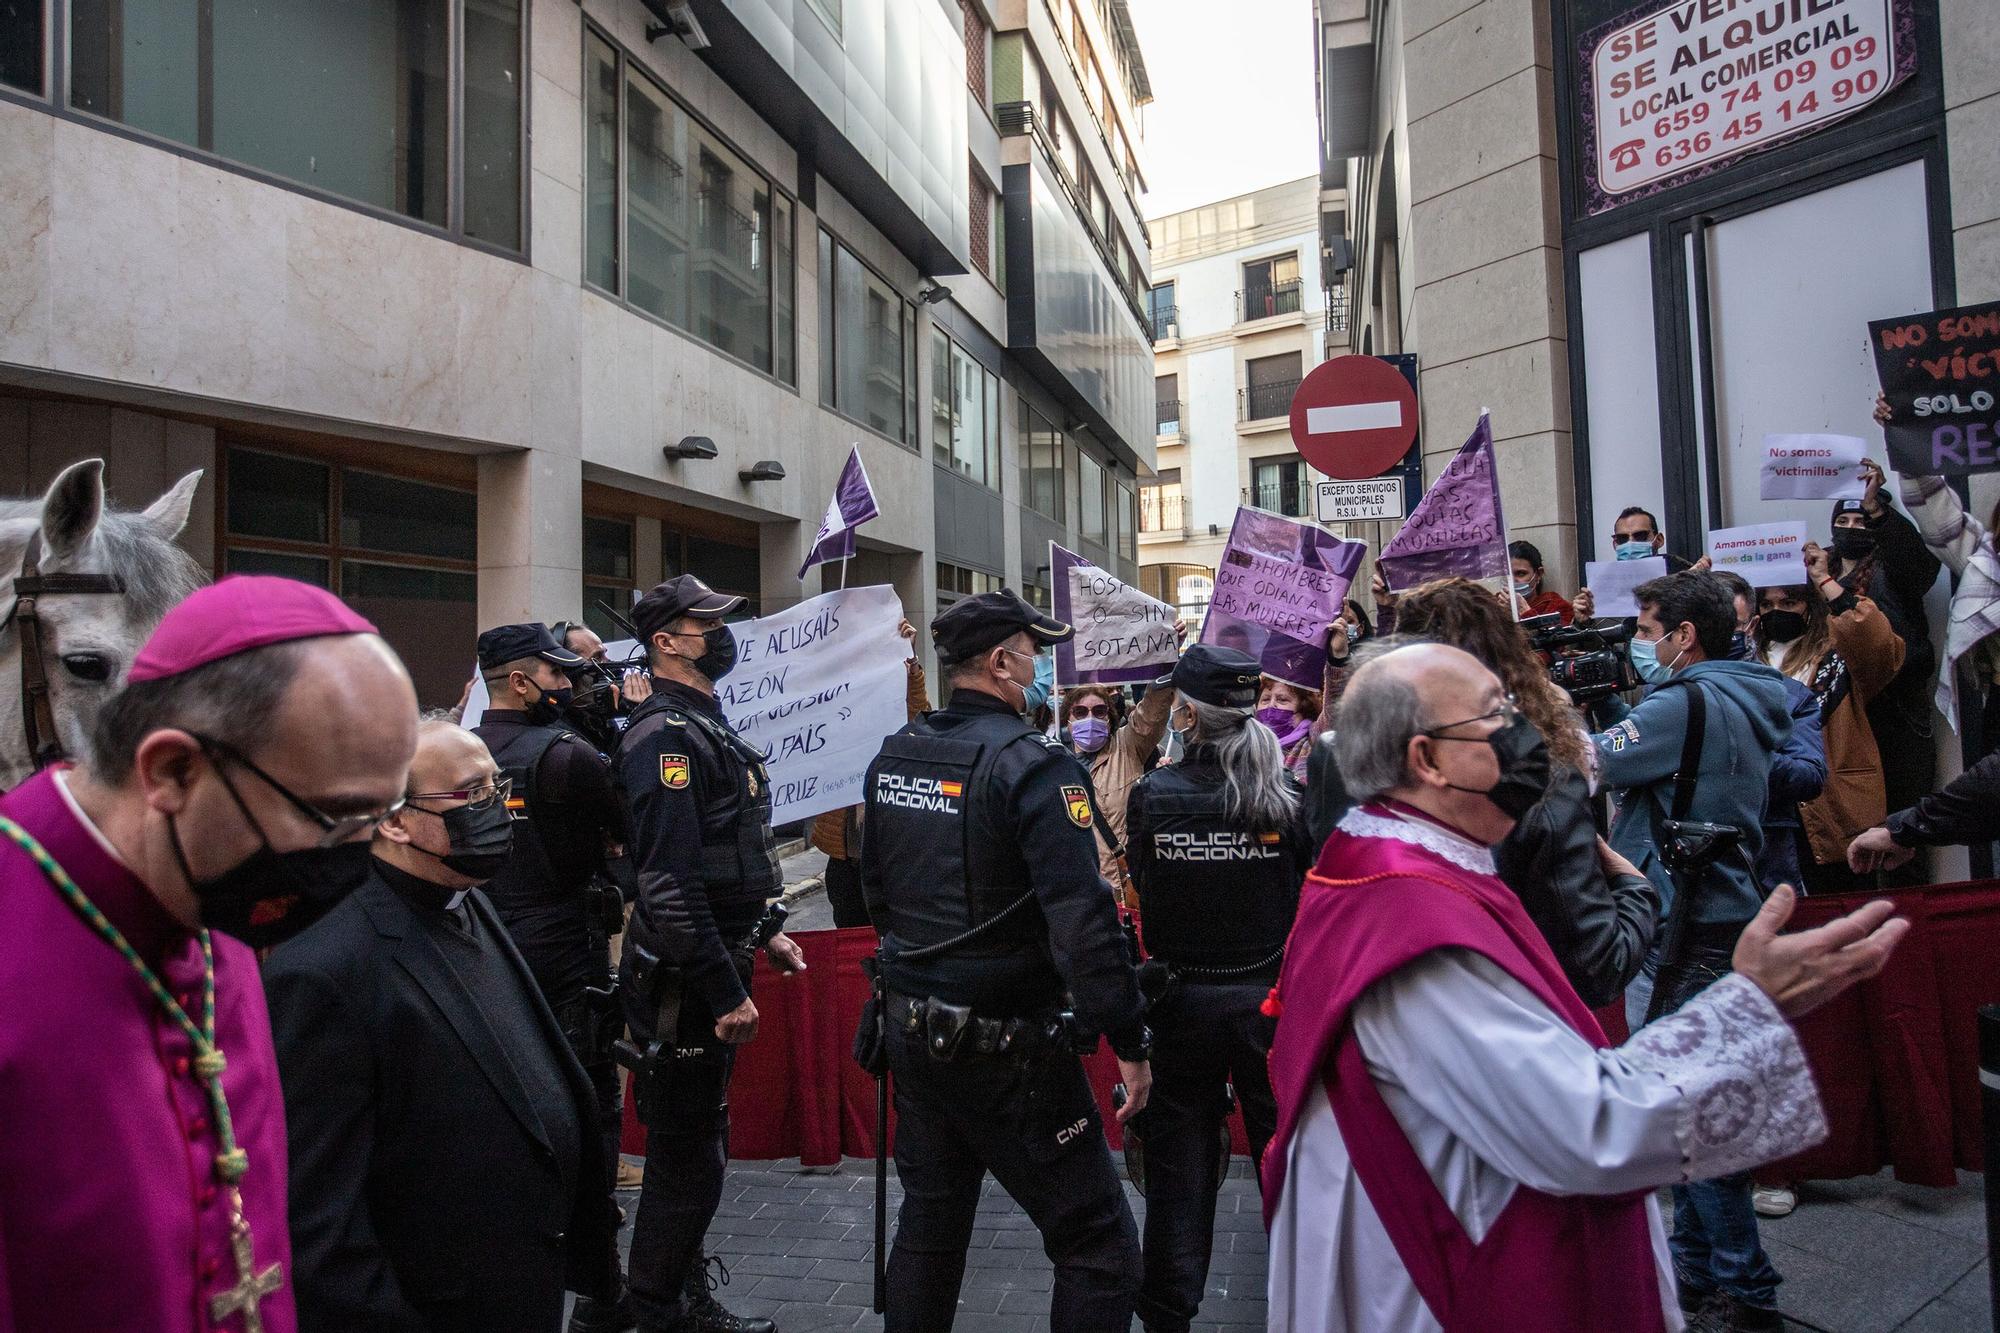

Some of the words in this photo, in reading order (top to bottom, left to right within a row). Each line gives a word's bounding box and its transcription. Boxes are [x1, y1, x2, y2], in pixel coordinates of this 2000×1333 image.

[1610, 22, 1658, 63] SE
[1610, 60, 1657, 99] SE
[1669, 0, 1847, 76] ALQUIL
[1619, 82, 1694, 127] LOCAL
[1701, 13, 1859, 94] COMERCIAL
[1654, 102, 1710, 139] 659
[1721, 84, 1762, 113] 74
[1774, 60, 1817, 93] 09
[1830, 36, 1876, 71] 09
[1655, 130, 1711, 168] 636
[1722, 112, 1763, 142] 45
[1776, 91, 1819, 123] 14
[1831, 69, 1878, 103] 90
[1881, 324, 1927, 350] NO
[1913, 390, 1994, 417] SOLO
[1769, 448, 1787, 458] No
[1790, 449, 1832, 458] somos
[1932, 420, 2000, 469] RE
[1322, 485, 1355, 496] EXCEPTO
[1357, 483, 1396, 494] SERVICIOS
[1335, 495, 1384, 506] MUNICIPALES
[1337, 508, 1358, 517] R.S.U.
[1362, 507, 1367, 515] Y
[1371, 507, 1383, 516] L.V.
[1714, 540, 1757, 551] Amamos
[1768, 535, 1797, 547] quien
[1720, 556, 1739, 565] nos
[1740, 553, 1753, 563] da
[1755, 552, 1764, 561] la
[1766, 551, 1791, 564] gana
[1262, 559, 1334, 594] HOMBRES
[1219, 570, 1245, 588] QUE
[1254, 580, 1304, 606] ODIAN
[1307, 601, 1317, 613] A
[1093, 606, 1106, 623] O
[1130, 601, 1167, 624] SIN
[1214, 592, 1238, 614] LAS
[1245, 602, 1318, 639] MUJERES
[765, 605, 841, 658] ACUSÁIS
[1085, 633, 1177, 658] SOTANA
[774, 776, 818, 807] CRUZ
[878, 773, 943, 795] POLICIA
[877, 789, 958, 814] NACIONAL
[1155, 846, 1280, 860] NACIONAL
[1056, 1118, 1088, 1144] CNP
